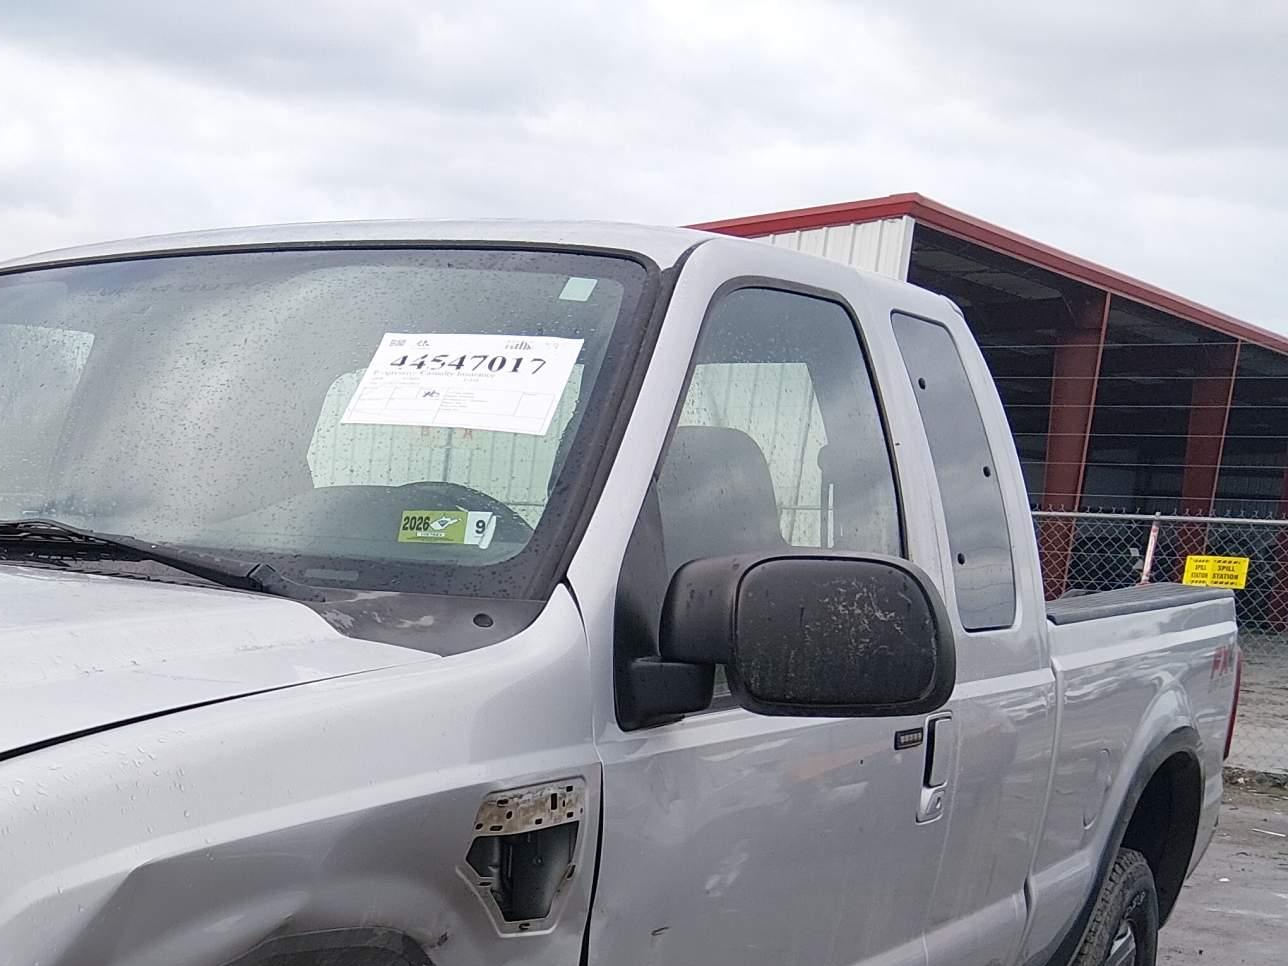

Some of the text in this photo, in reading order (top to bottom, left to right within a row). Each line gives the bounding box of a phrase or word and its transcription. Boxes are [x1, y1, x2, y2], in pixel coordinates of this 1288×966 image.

[389, 353, 547, 376] 44547017
[402, 516, 431, 531] 2026
[475, 519, 486, 535] 9
[1212, 572, 1239, 580] STATION
